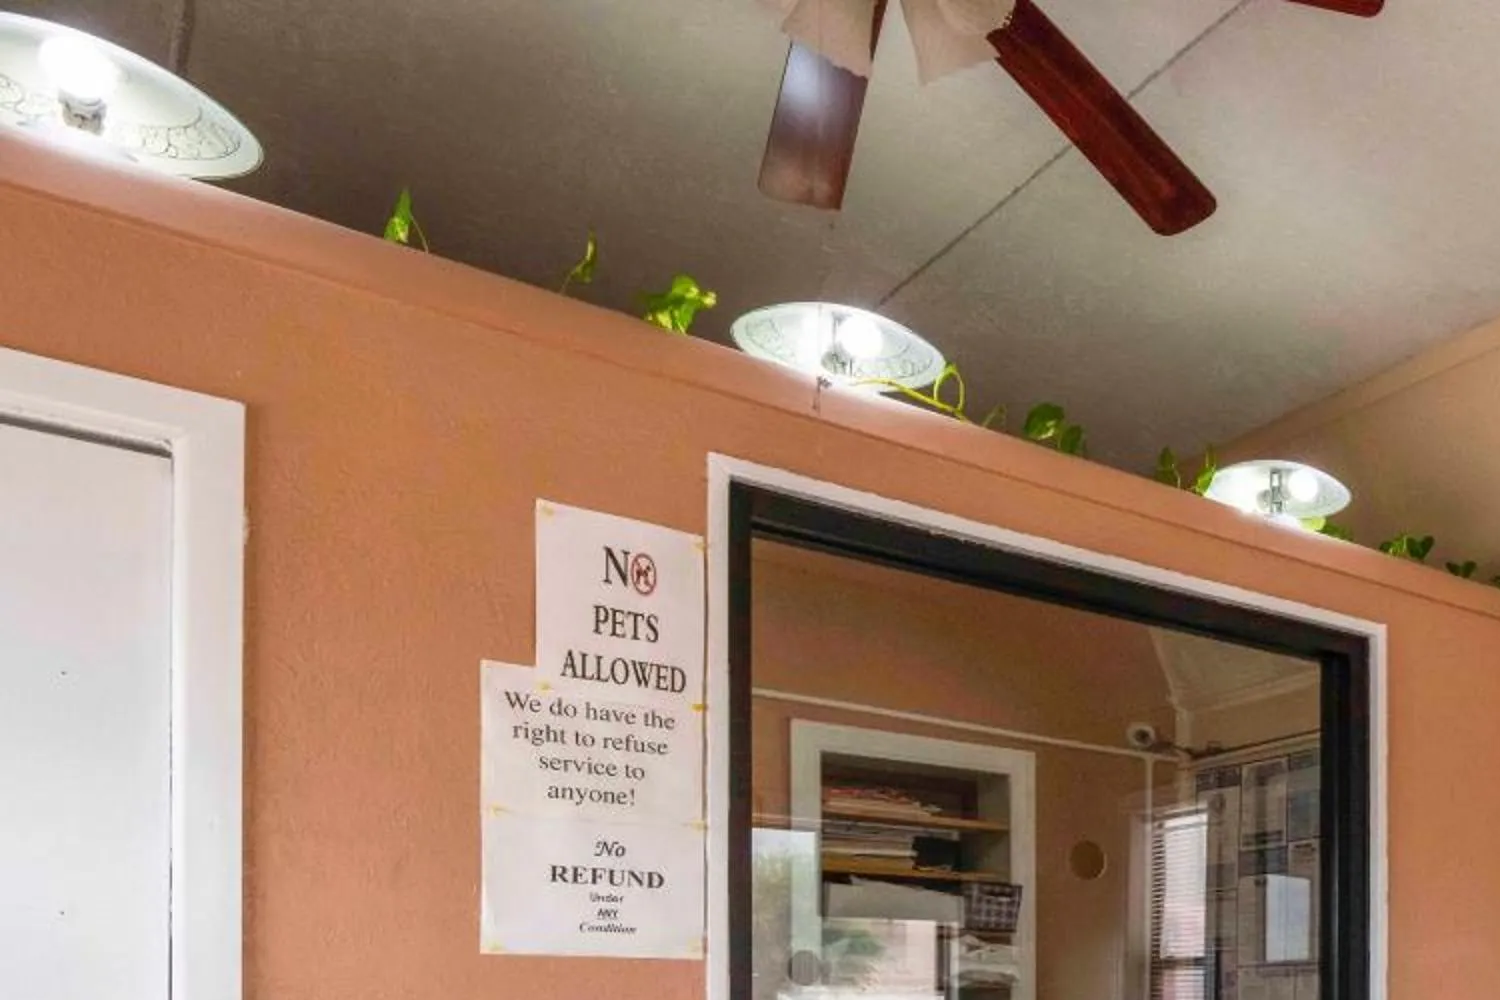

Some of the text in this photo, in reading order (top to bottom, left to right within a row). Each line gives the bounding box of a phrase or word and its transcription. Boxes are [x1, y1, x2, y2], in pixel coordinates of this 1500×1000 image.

[593, 605, 659, 643] PETS
[560, 649, 687, 693] ALLOWED
[504, 690, 675, 730] We do have the
[512, 721, 668, 755] right to refuse
[539, 756, 645, 780] service to
[547, 785, 635, 806] anyone!
[594, 841, 626, 857] No
[550, 865, 665, 888] REFUND
